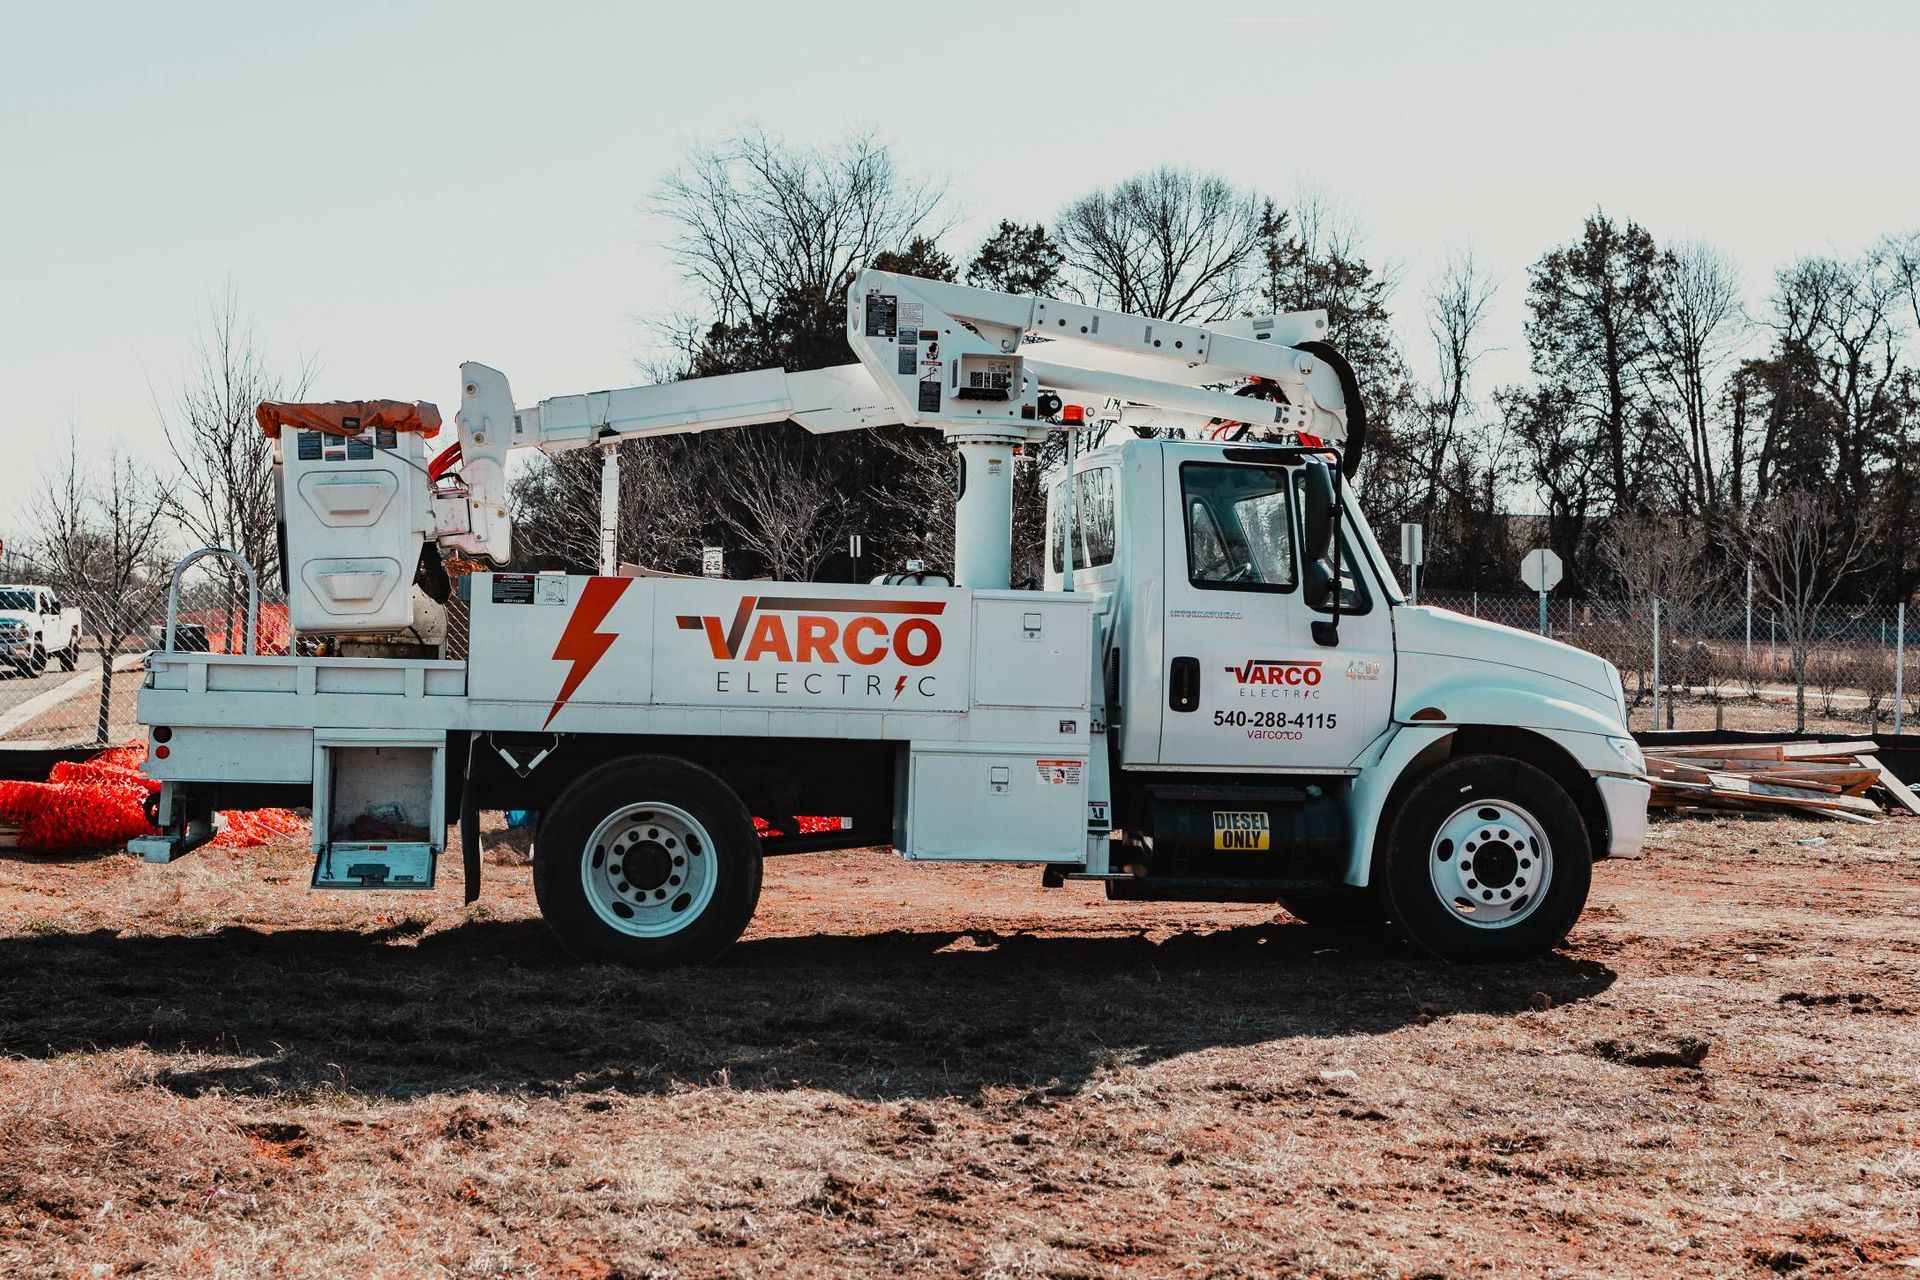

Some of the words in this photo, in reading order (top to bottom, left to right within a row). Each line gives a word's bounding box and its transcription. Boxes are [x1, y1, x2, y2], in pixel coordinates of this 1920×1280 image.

[705, 561, 720, 570] 25
[676, 595, 946, 666] VARCO
[1224, 659, 1323, 686] VARCO
[716, 670, 937, 701] ELECTRIC
[1239, 688, 1321, 700] ELECTRIC
[1213, 710, 1337, 729] 540-288-4115
[1214, 813, 1269, 829] DIESEL
[1222, 830, 1261, 848] ONLY
